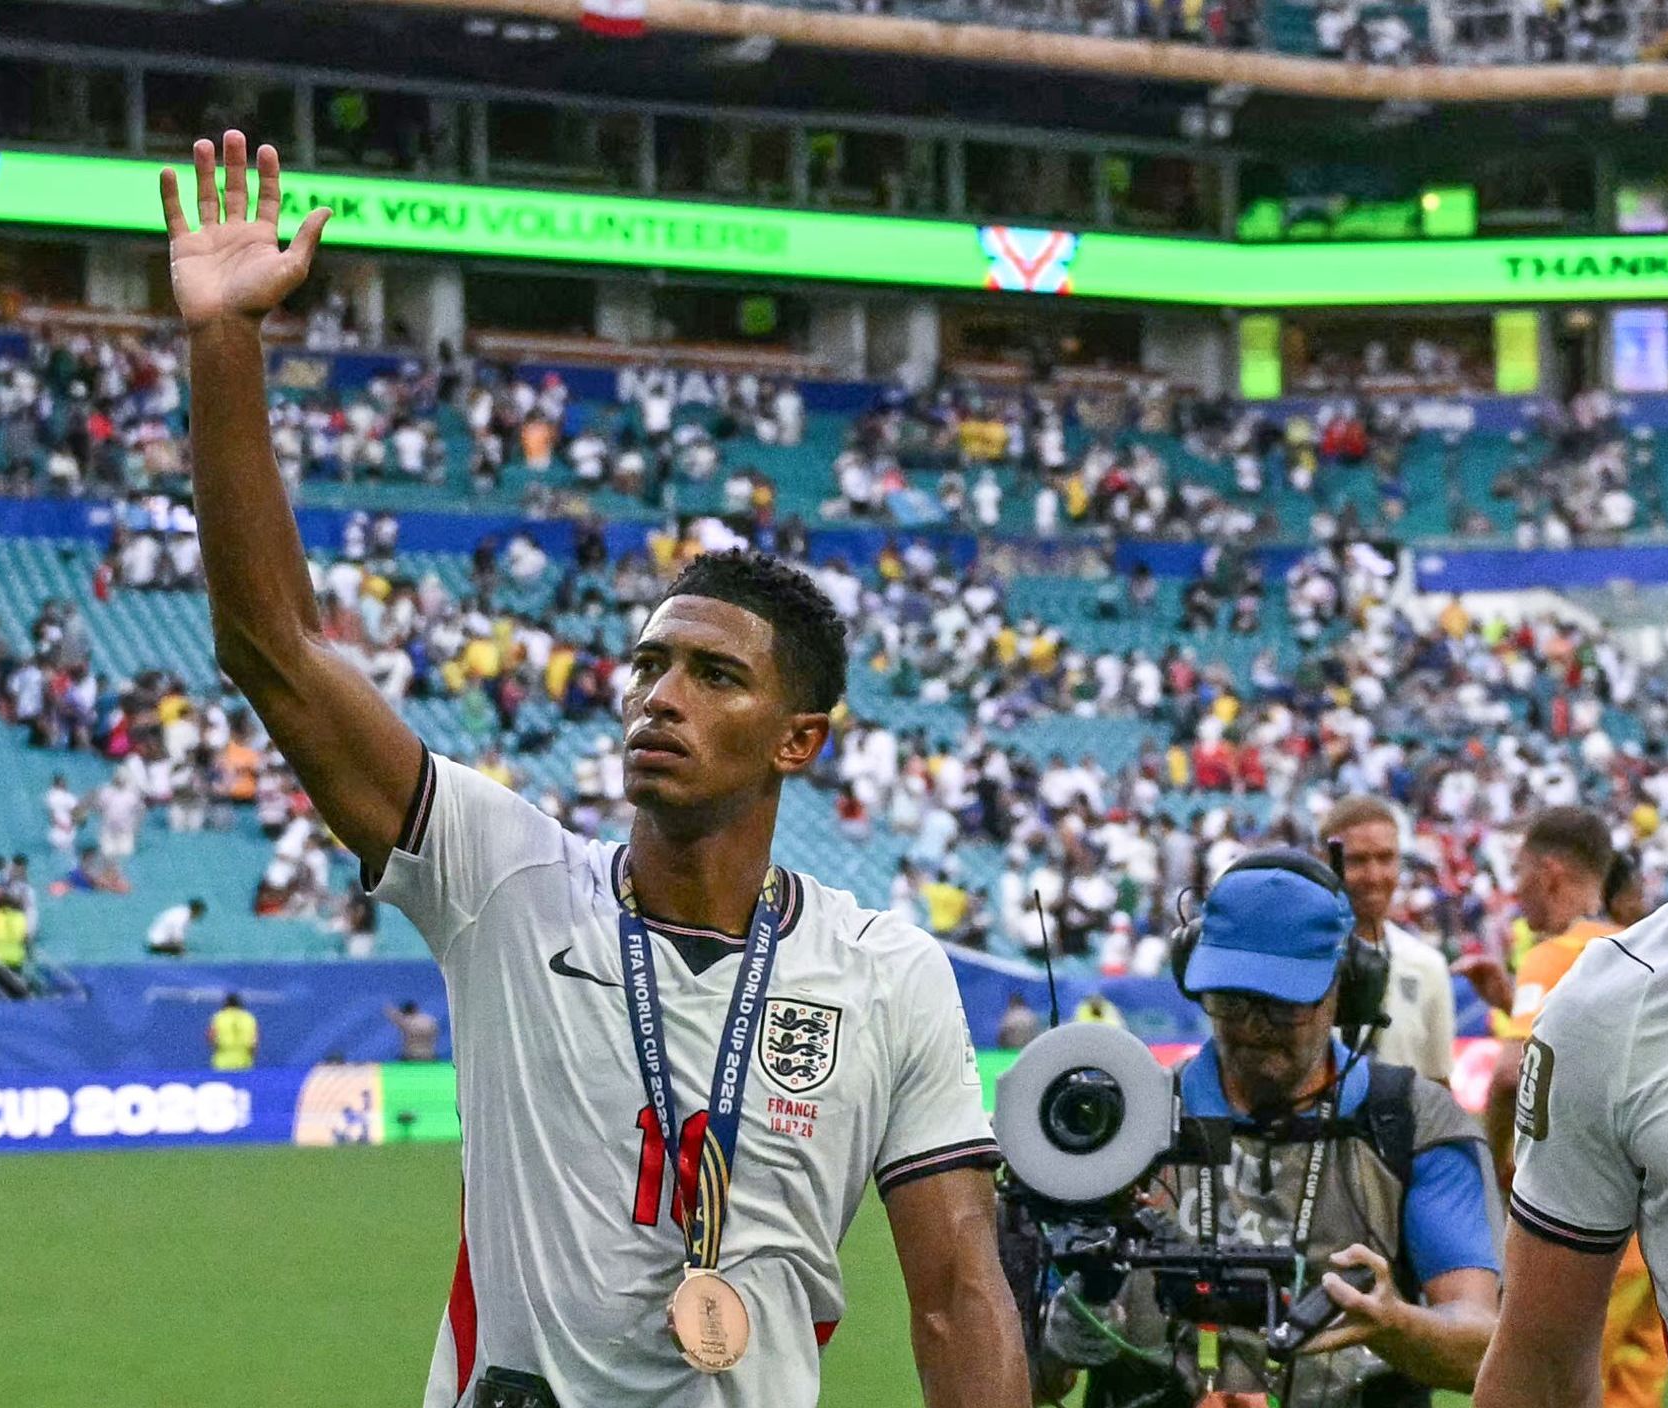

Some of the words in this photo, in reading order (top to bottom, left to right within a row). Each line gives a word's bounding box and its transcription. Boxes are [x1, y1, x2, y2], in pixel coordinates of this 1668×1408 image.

[383, 199, 467, 230] YOU
[627, 934, 644, 970] FIFA
[754, 921, 772, 958] FIFA
[739, 955, 766, 1014] WORLD
[633, 972, 654, 1036] WORLD
[730, 1016, 750, 1050] CUP
[643, 1037, 660, 1073] CUP
[718, 1052, 741, 1115] 2026
[650, 1076, 670, 1139] 2026
[767, 1098, 818, 1120] FRANCE
